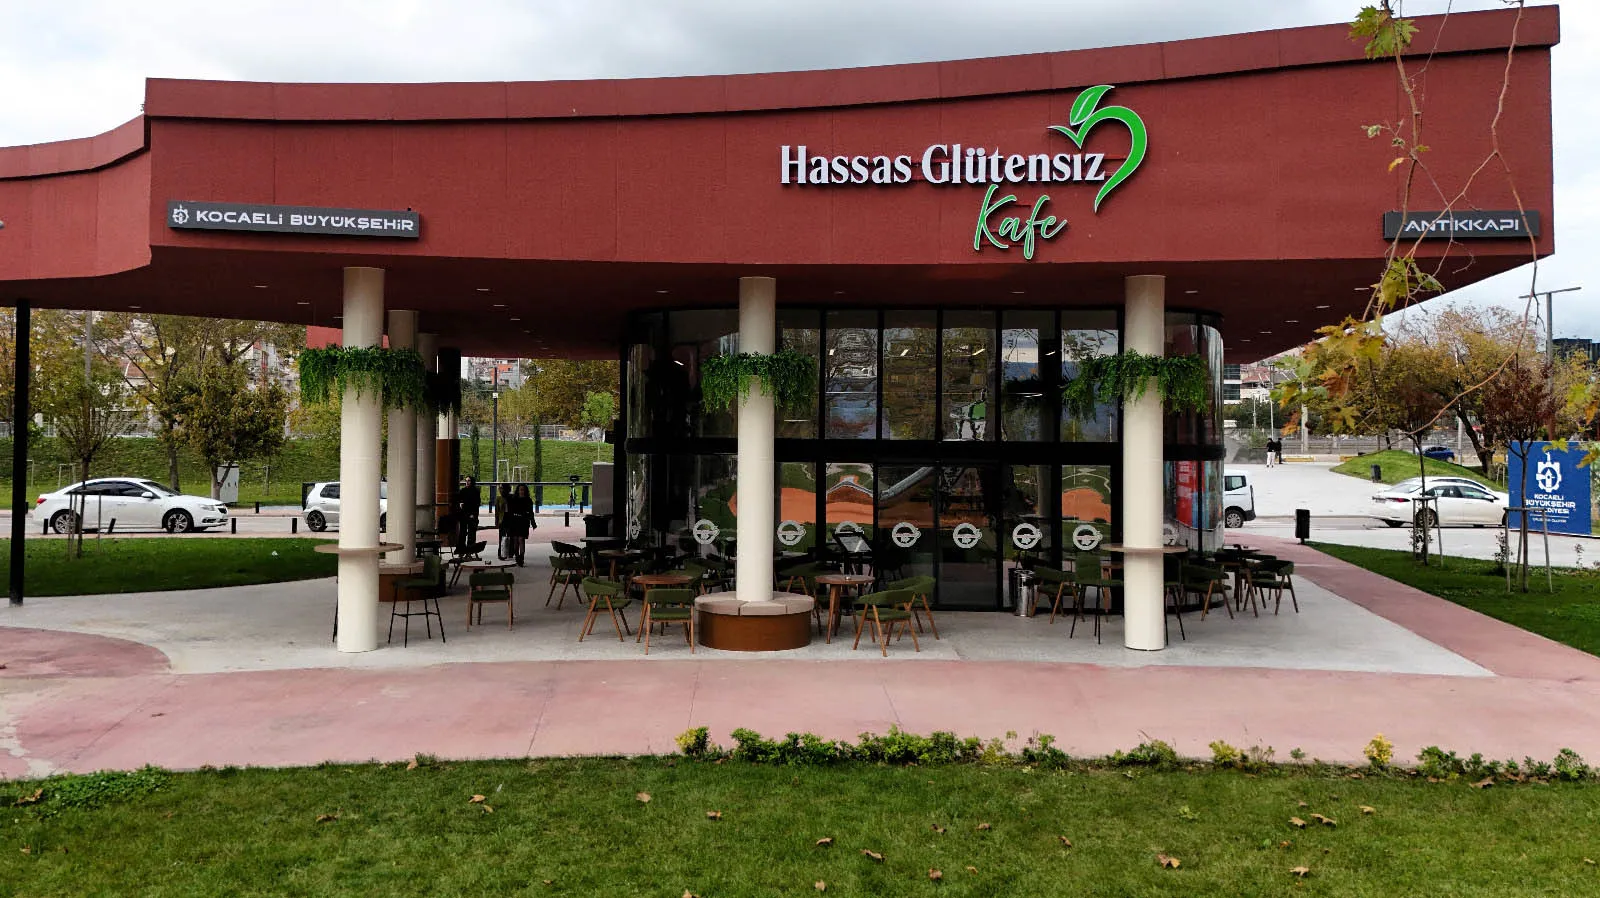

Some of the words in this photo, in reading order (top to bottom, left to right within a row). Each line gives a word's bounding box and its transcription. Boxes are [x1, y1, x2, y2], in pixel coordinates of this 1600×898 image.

[780, 145, 912, 184] Hassas
[921, 143, 1106, 184] Glütensız
[973, 184, 1068, 260] Kafe
